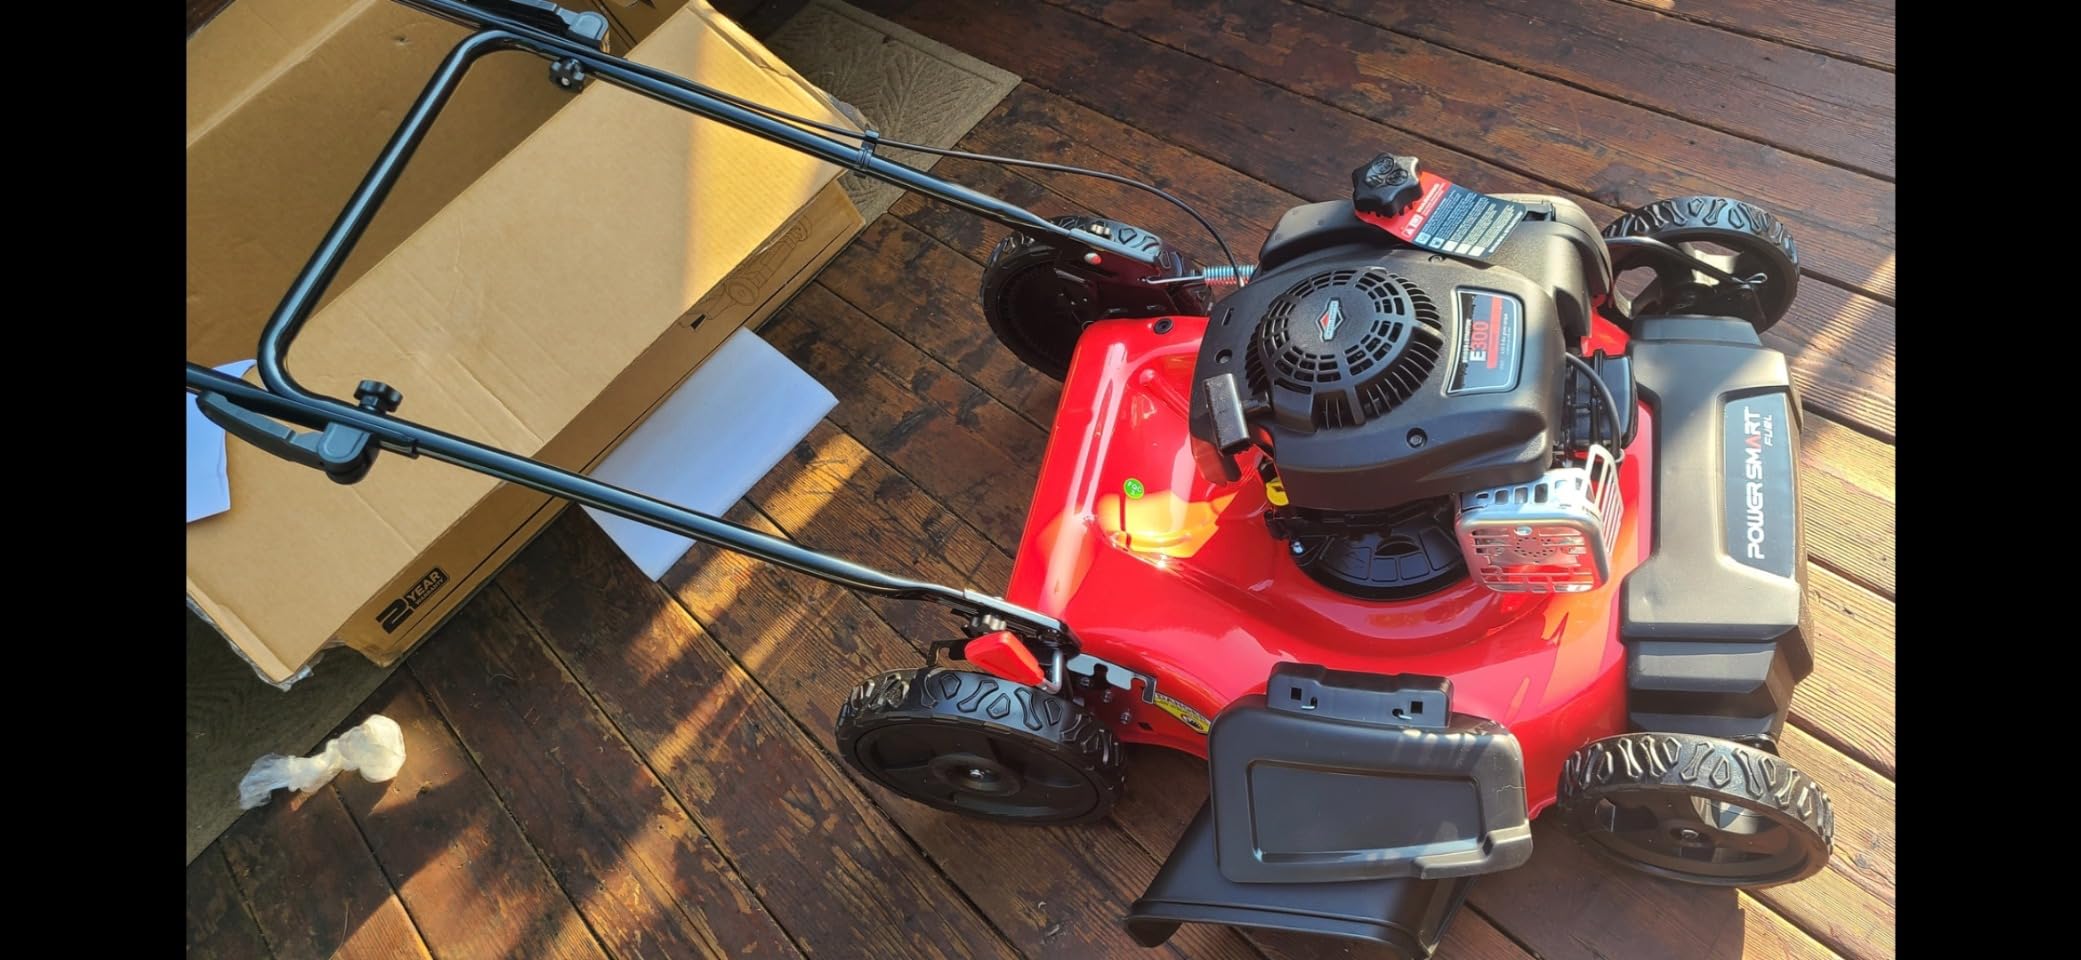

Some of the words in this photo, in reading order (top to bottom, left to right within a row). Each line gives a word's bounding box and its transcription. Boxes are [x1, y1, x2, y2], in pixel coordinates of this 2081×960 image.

[1469, 320, 1489, 361] E300
[1744, 406, 1763, 480] SMART
[1763, 414, 1774, 447] FUEL
[1747, 482, 1765, 559] POWER
[376, 598, 414, 634] 2
[406, 571, 441, 602] YEAR
